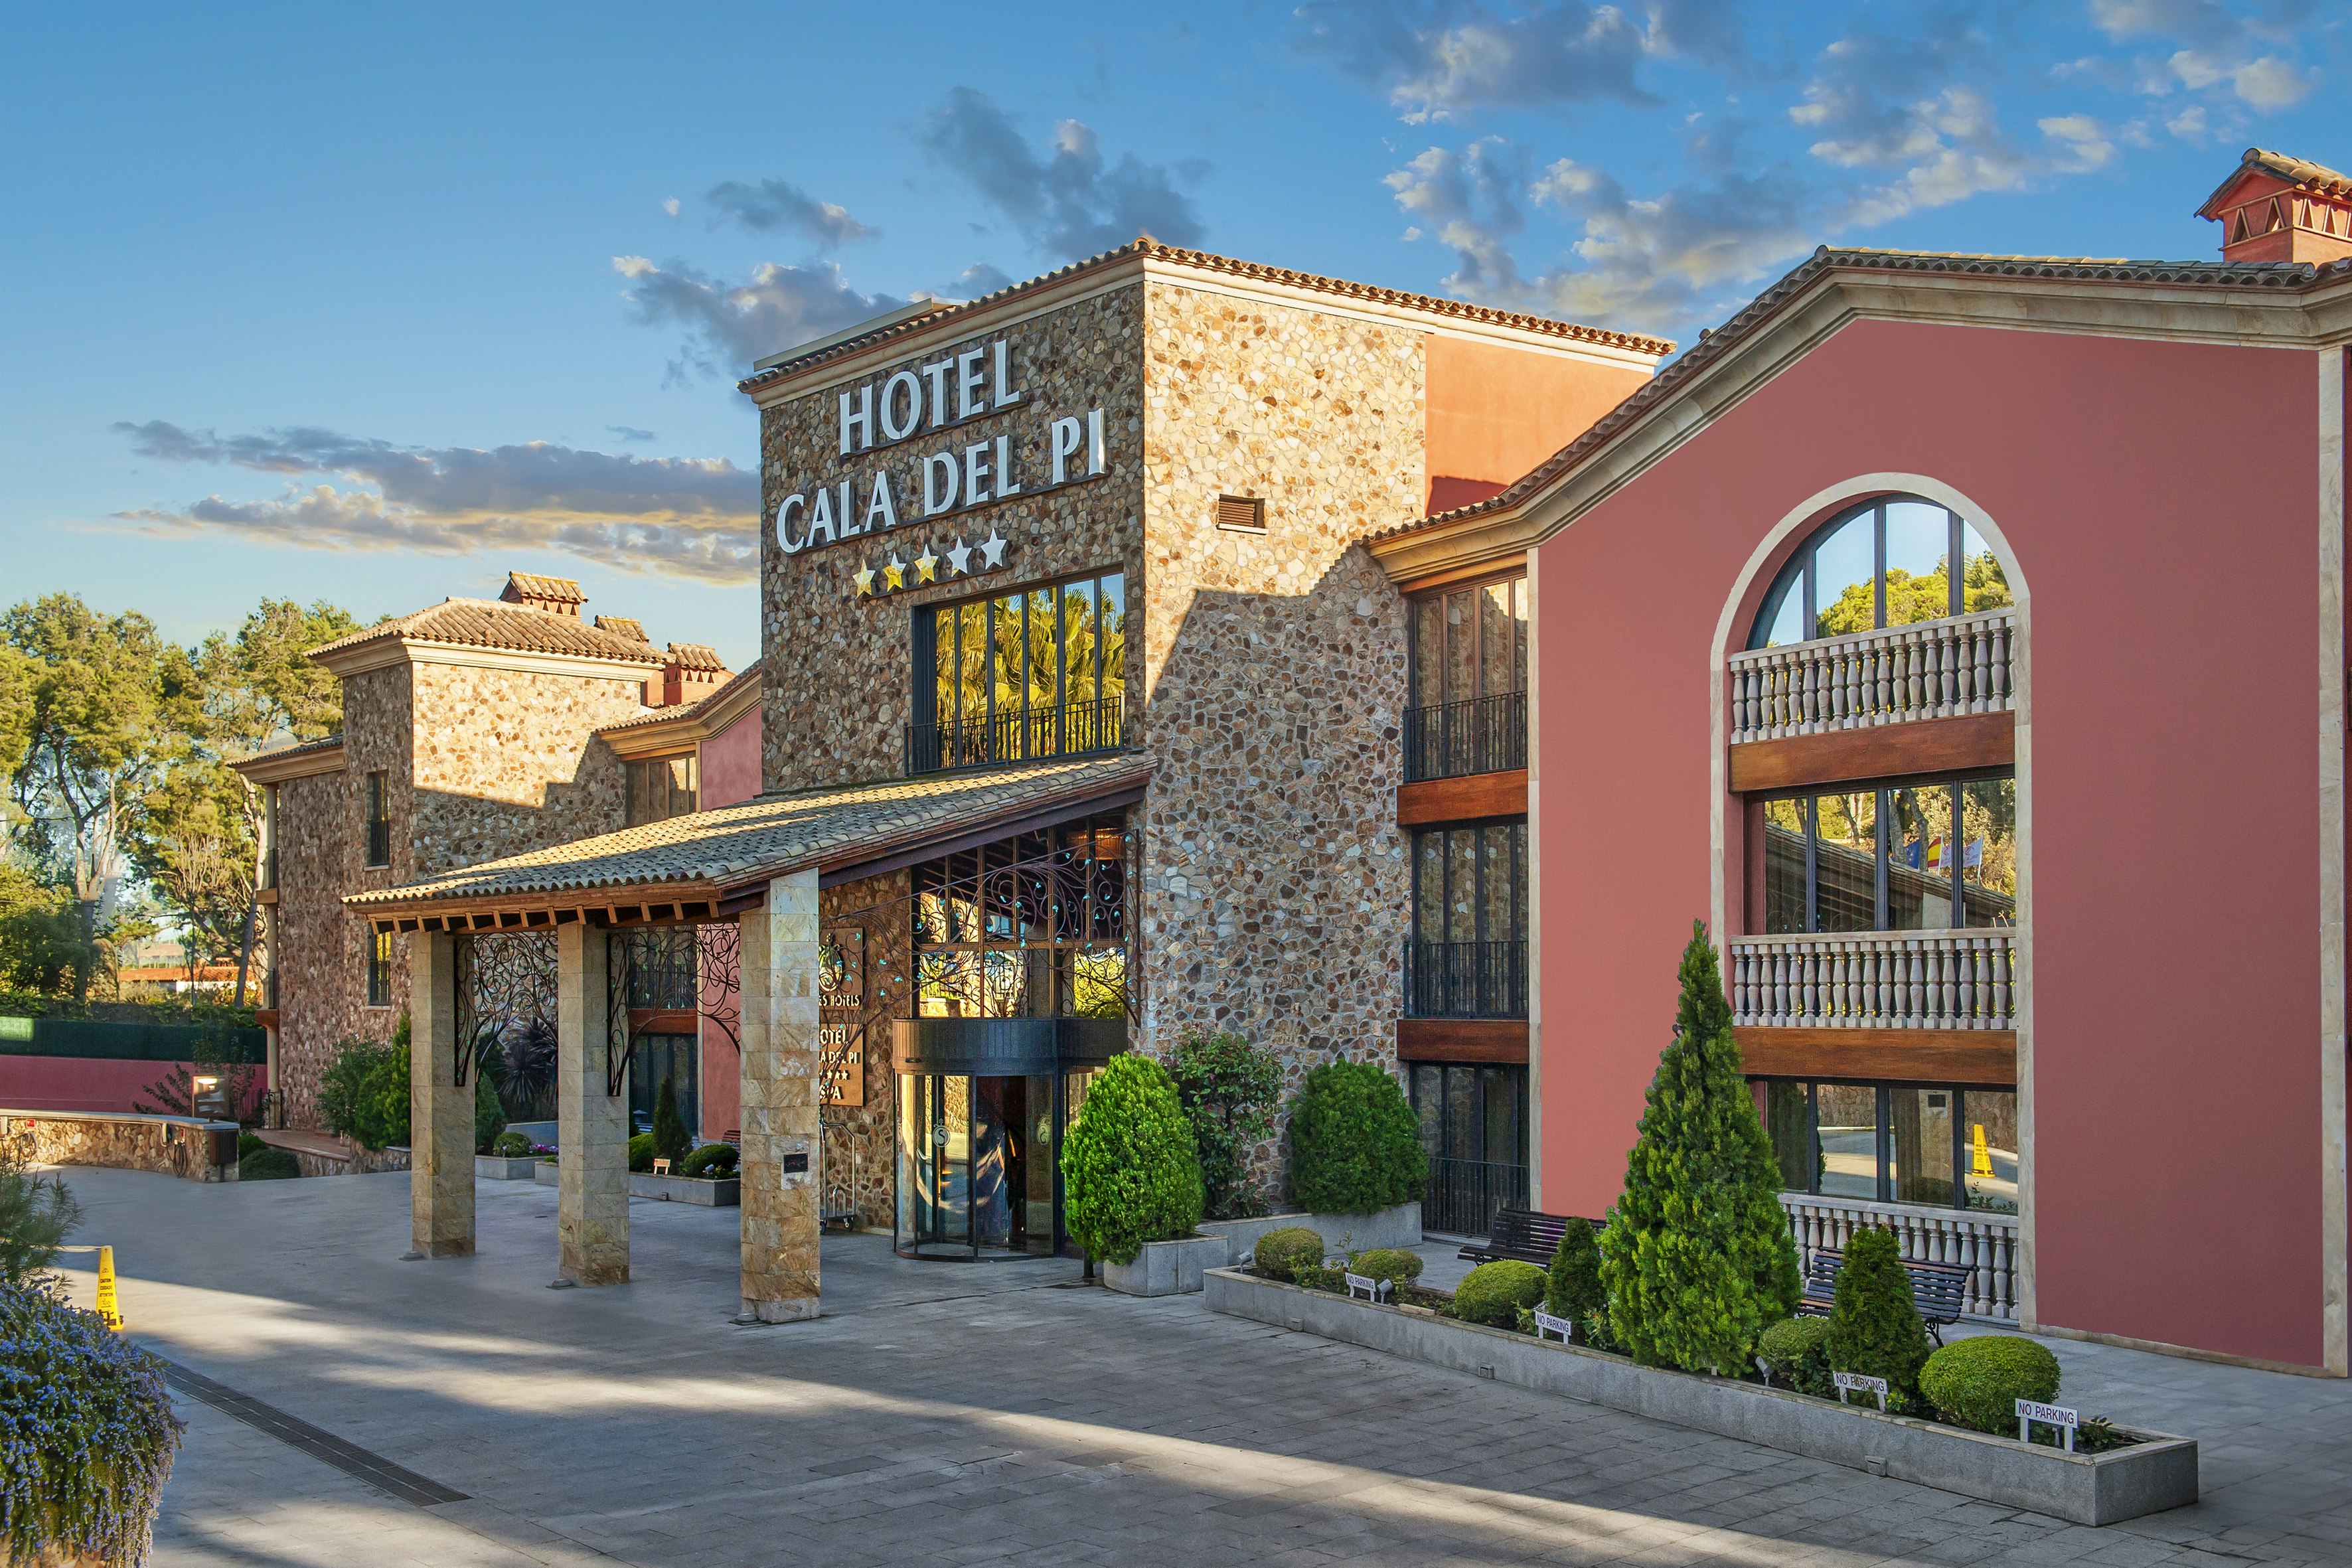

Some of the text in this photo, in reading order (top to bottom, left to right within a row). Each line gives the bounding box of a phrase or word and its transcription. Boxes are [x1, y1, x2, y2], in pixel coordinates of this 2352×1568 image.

[840, 339, 1021, 456] HOTEL
[777, 408, 1106, 554] CALA DEL PI
[830, 994, 860, 1006] HOTELS
[819, 1029, 848, 1044] OTEL
[848, 1052, 858, 1064] PI
[1346, 1275, 1374, 1289] NO PARKING
[1537, 1314, 1569, 1332] NO PARKING
[1836, 1373, 1885, 1392] NO PARKING
[2019, 1402, 2075, 1425] NO PARKING
